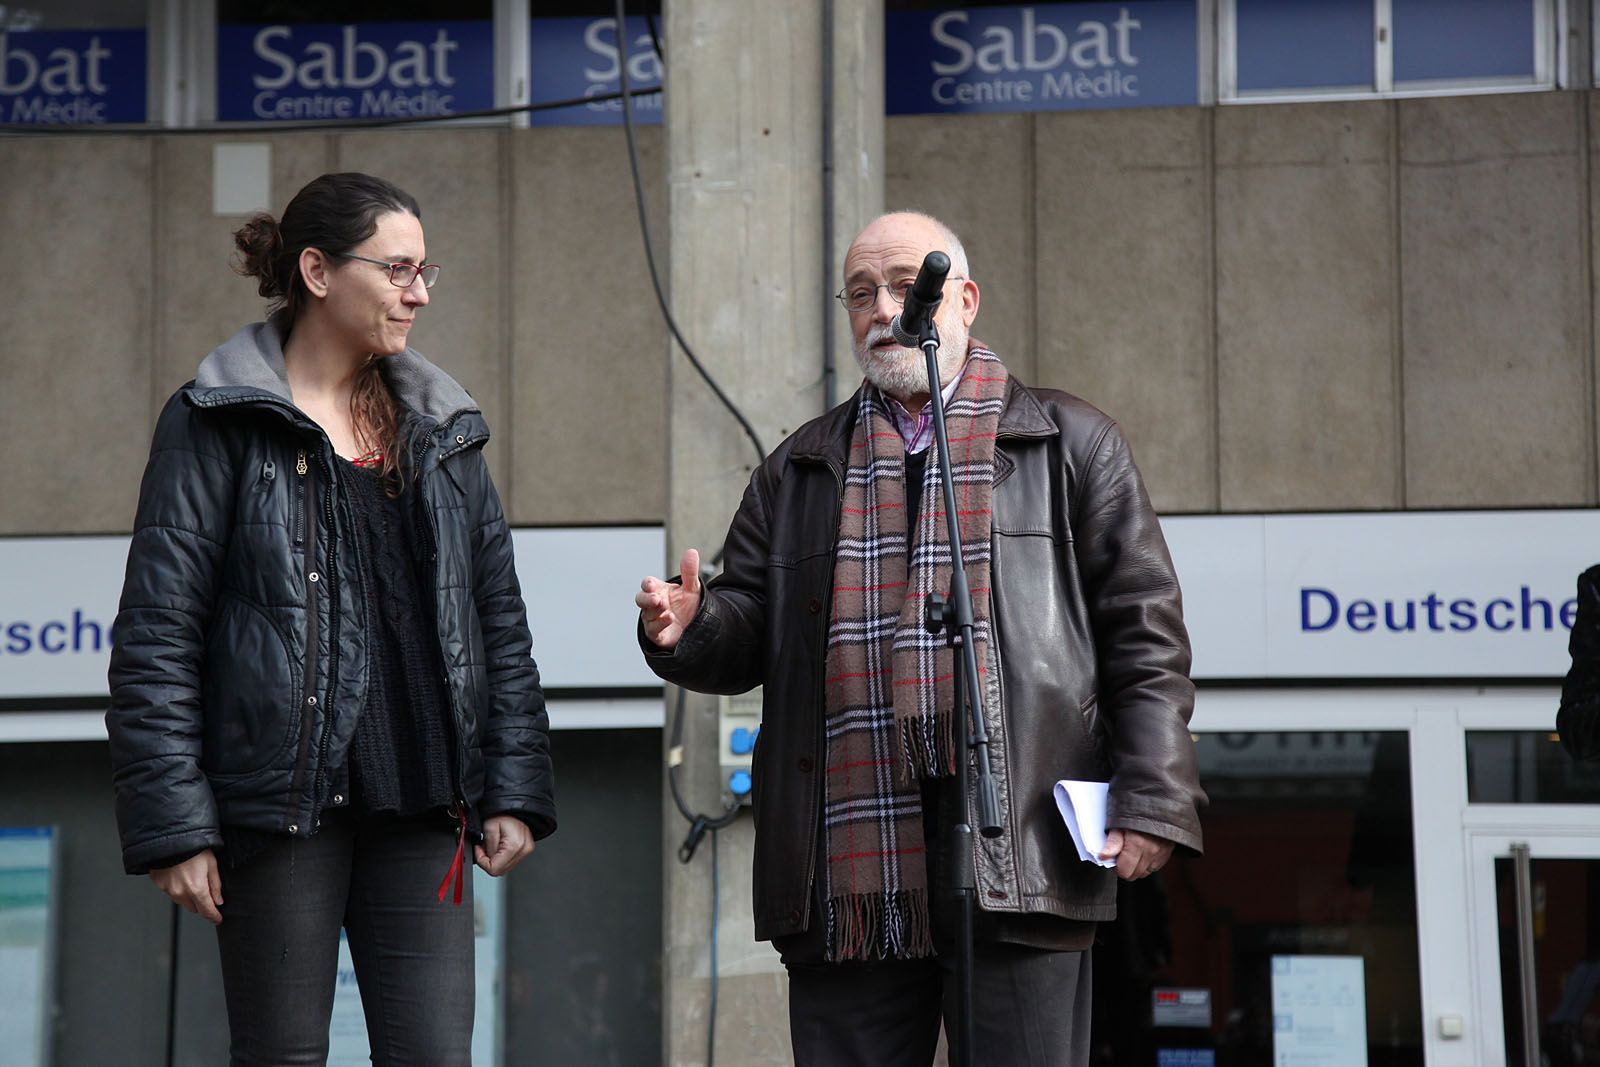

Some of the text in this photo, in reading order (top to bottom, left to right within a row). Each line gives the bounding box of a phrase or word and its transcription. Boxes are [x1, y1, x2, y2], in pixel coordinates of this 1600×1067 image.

[253, 25, 458, 89] Sabat
[930, 7, 1141, 74] Sabat
[253, 89, 455, 118] Centre Mèdic
[931, 69, 1139, 104] Centre Mèdic
[1299, 585, 1579, 632] Deutsche
